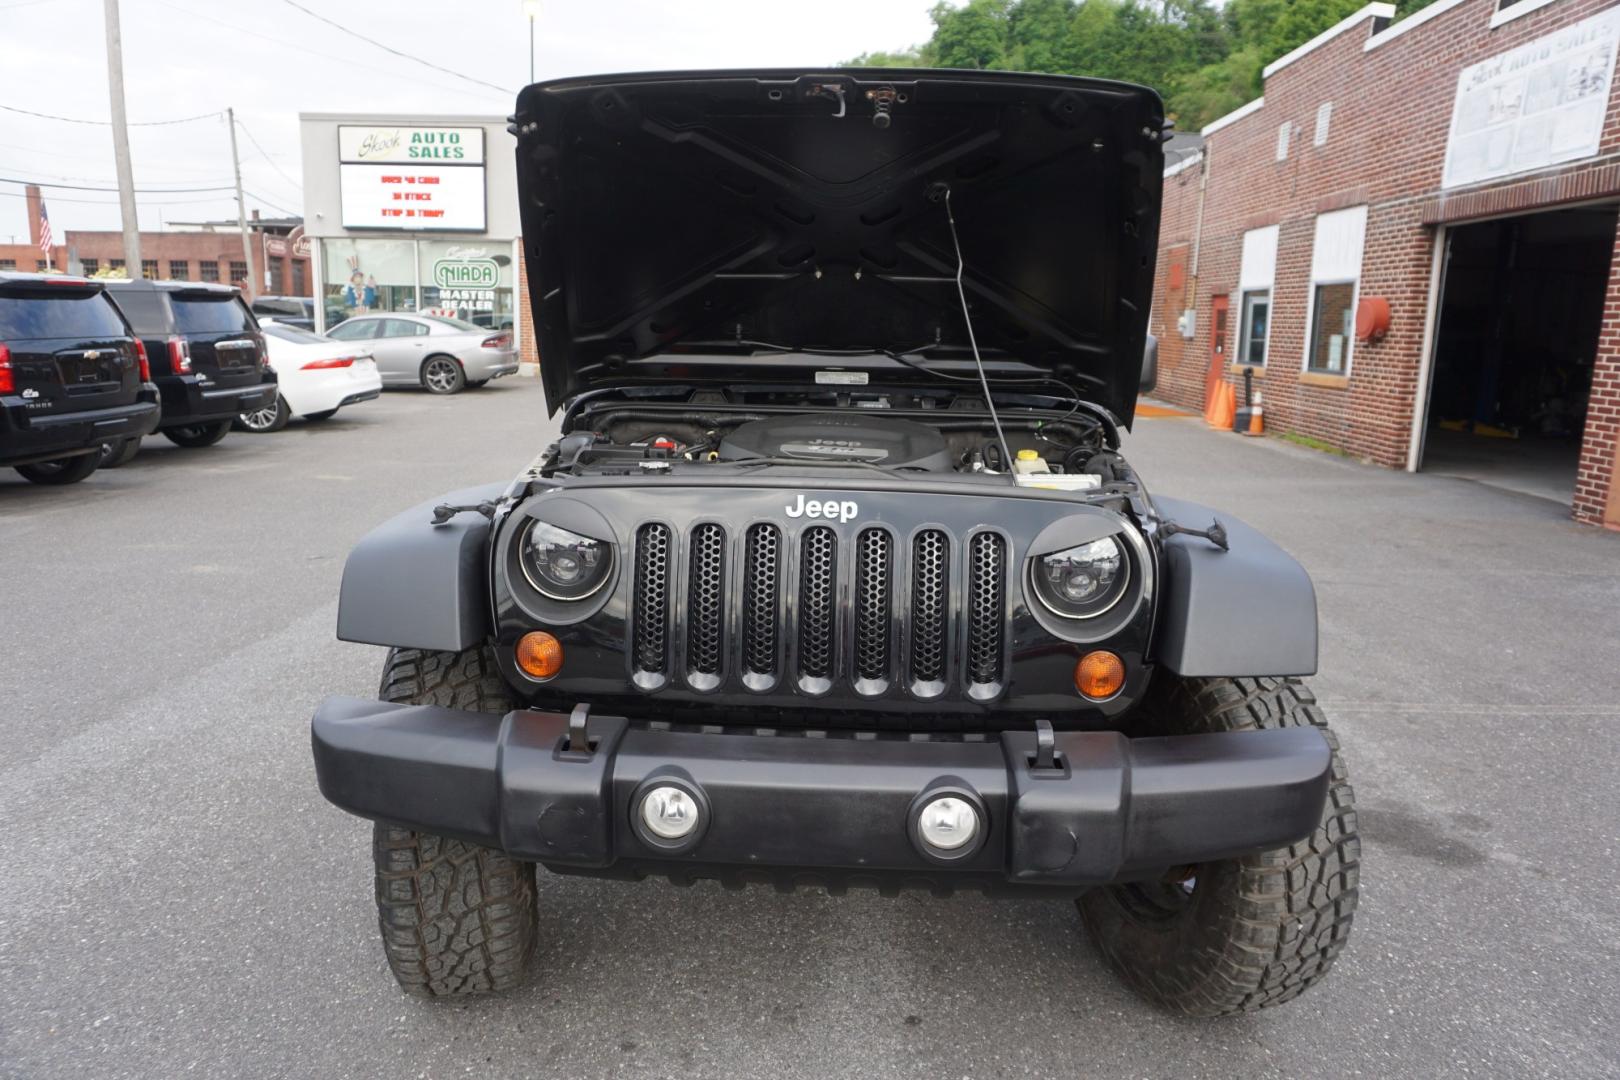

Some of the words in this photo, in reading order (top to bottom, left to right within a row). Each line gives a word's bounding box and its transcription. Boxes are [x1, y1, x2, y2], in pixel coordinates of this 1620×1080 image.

[411, 132, 460, 144] AUTO
[408, 146, 465, 159] SALES
[440, 266, 492, 283] NIADA
[439, 289, 495, 300] MASTER
[441, 300, 494, 312] DEALER
[785, 494, 858, 524] Jeep
